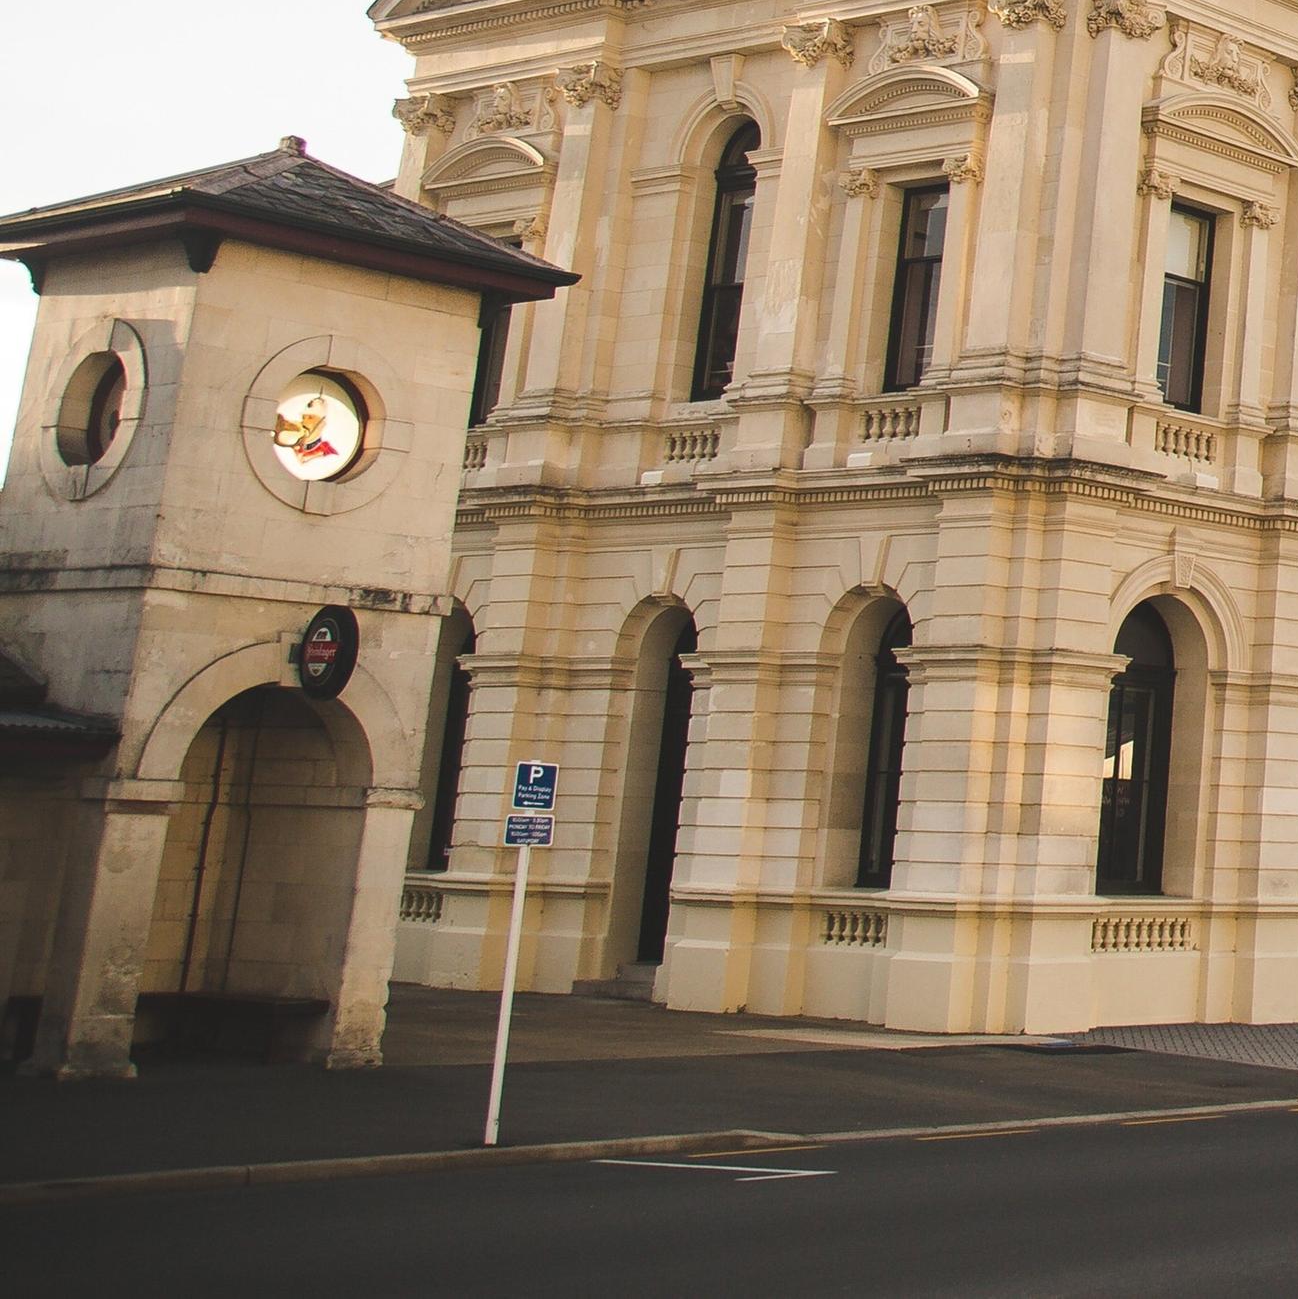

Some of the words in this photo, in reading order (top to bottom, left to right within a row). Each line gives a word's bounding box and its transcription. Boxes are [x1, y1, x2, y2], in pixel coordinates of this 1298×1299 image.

[529, 766, 544, 784] P
[518, 784, 528, 792] Pay
[533, 785, 552, 793] Display
[518, 792, 537, 800] Parking
